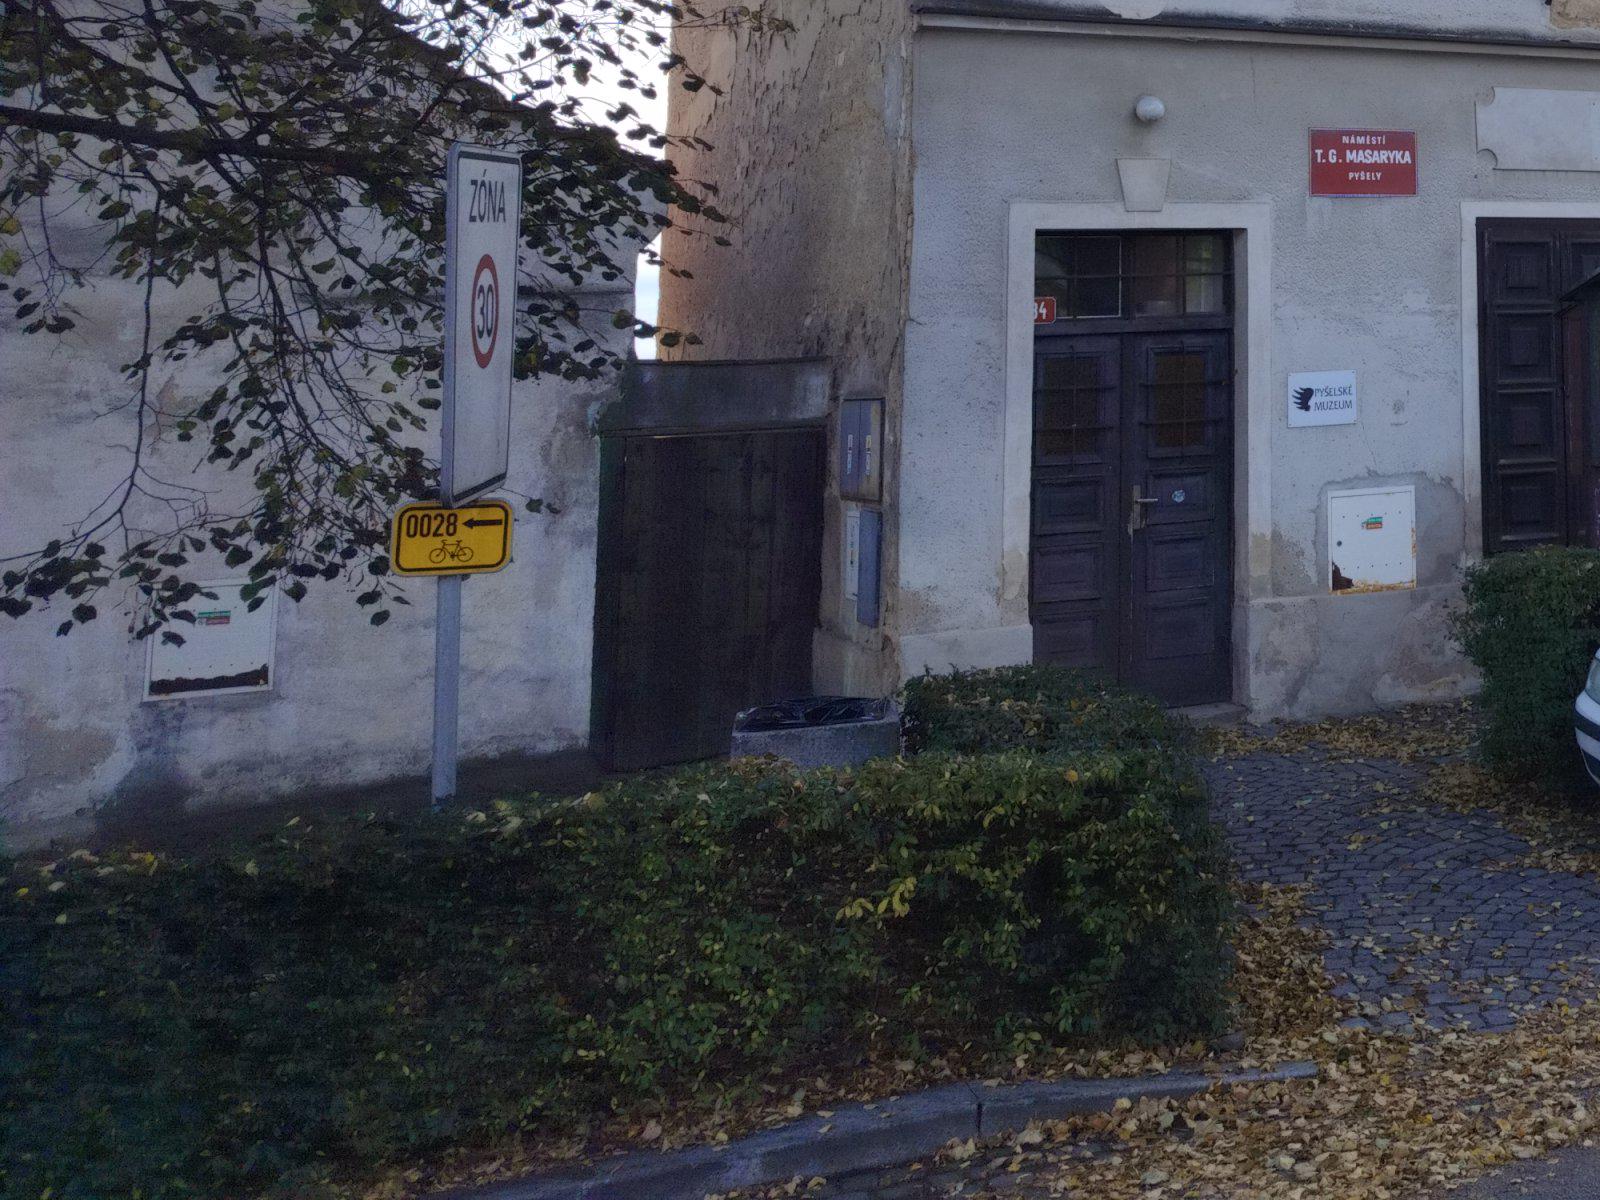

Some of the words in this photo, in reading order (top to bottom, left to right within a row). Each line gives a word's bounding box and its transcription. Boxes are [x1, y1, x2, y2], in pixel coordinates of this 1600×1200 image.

[1342, 135, 1386, 145] NÁMĚSTÍ
[1345, 149, 1412, 165] MASARYKA
[1348, 171, 1382, 181] PYŠELY
[468, 168, 507, 224] ZÓNA
[476, 283, 495, 339] 30
[1314, 385, 1353, 398] PYŠELSKÉ
[1314, 400, 1353, 412] MUZEUM
[406, 513, 459, 538] 0028
